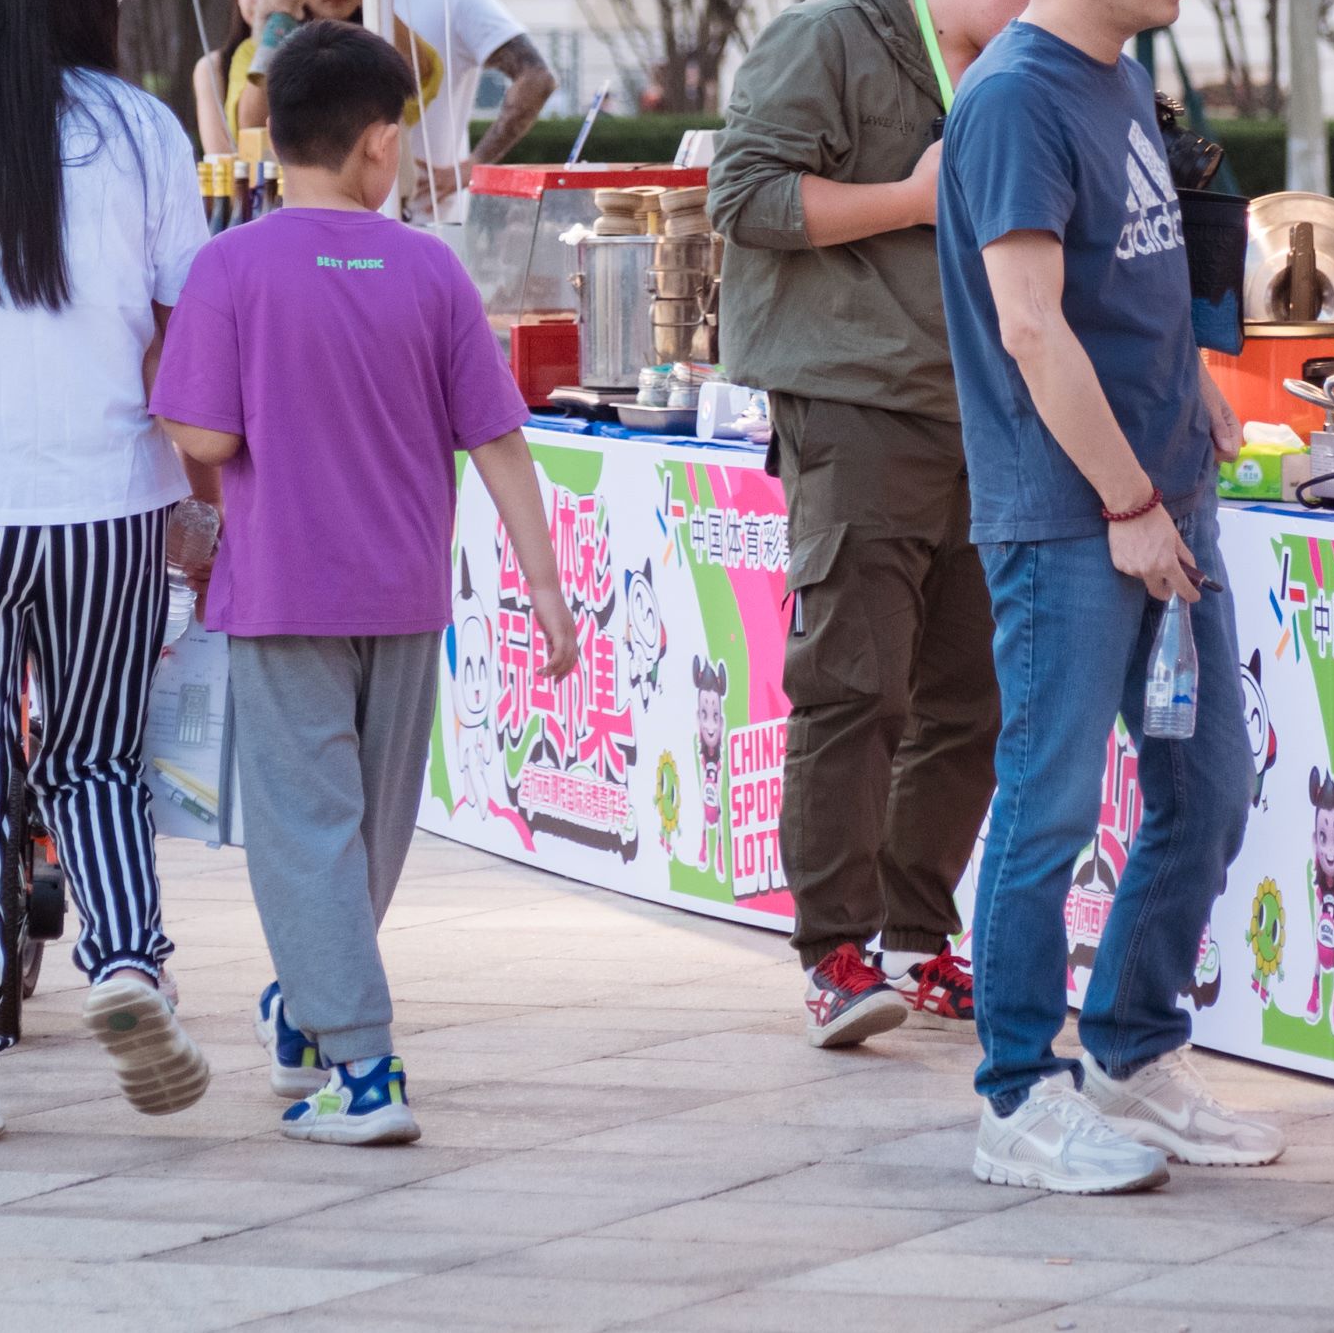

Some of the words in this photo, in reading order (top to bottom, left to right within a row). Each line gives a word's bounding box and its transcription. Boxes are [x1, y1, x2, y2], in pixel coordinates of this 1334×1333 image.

[1115, 202, 1185, 260] adida
[317, 256, 343, 269] BEST
[347, 258, 384, 270] MUSIC
[497, 489, 613, 606] 公体彩
[730, 724, 788, 778] CHINA
[731, 777, 783, 829] SPOR
[733, 829, 780, 879] LOTT
